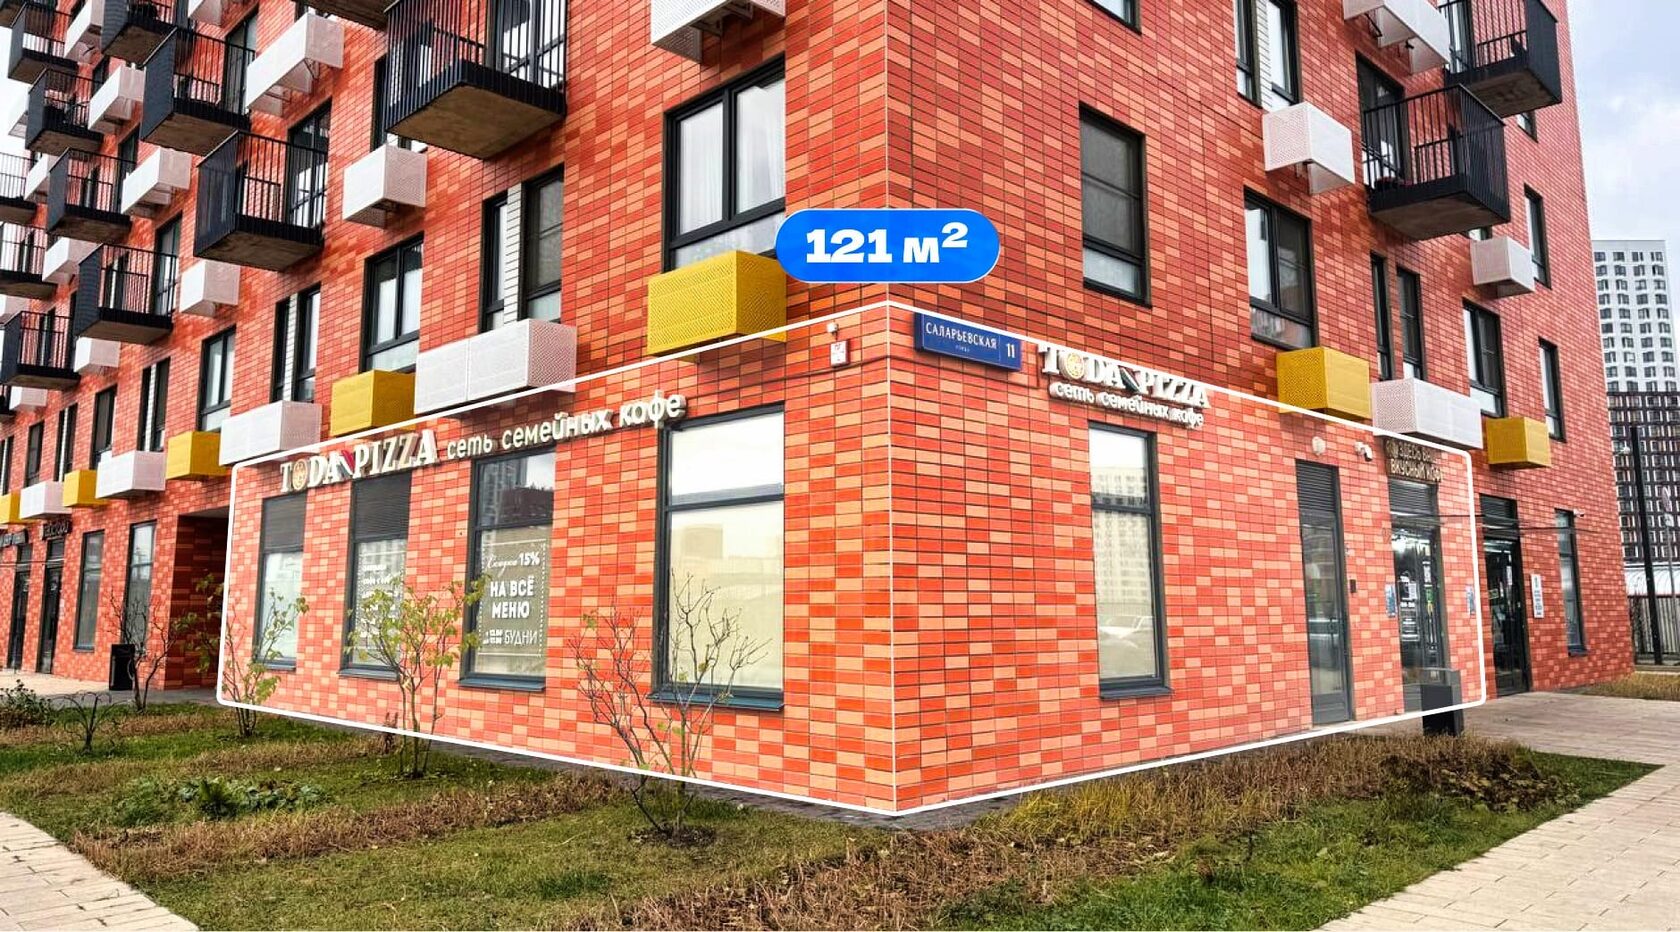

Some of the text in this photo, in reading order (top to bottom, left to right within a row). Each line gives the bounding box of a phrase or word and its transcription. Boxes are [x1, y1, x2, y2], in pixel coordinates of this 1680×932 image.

[925, 321, 997, 350] САЛАРЬЕВСКАЯ
[1006, 343, 1016, 358] 11
[1050, 381, 1095, 402] сеть
[1097, 391, 1169, 418] семейных
[1133, 369, 1212, 409] PIZZA
[447, 389, 687, 459] сеть семейных кафе
[280, 428, 439, 493] TODA PIZZA
[519, 551, 540, 567] 15%
[490, 575, 534, 597] НА ВСЁ
[492, 601, 530, 619] МЕНЮ
[504, 629, 538, 646] БУДНИ
